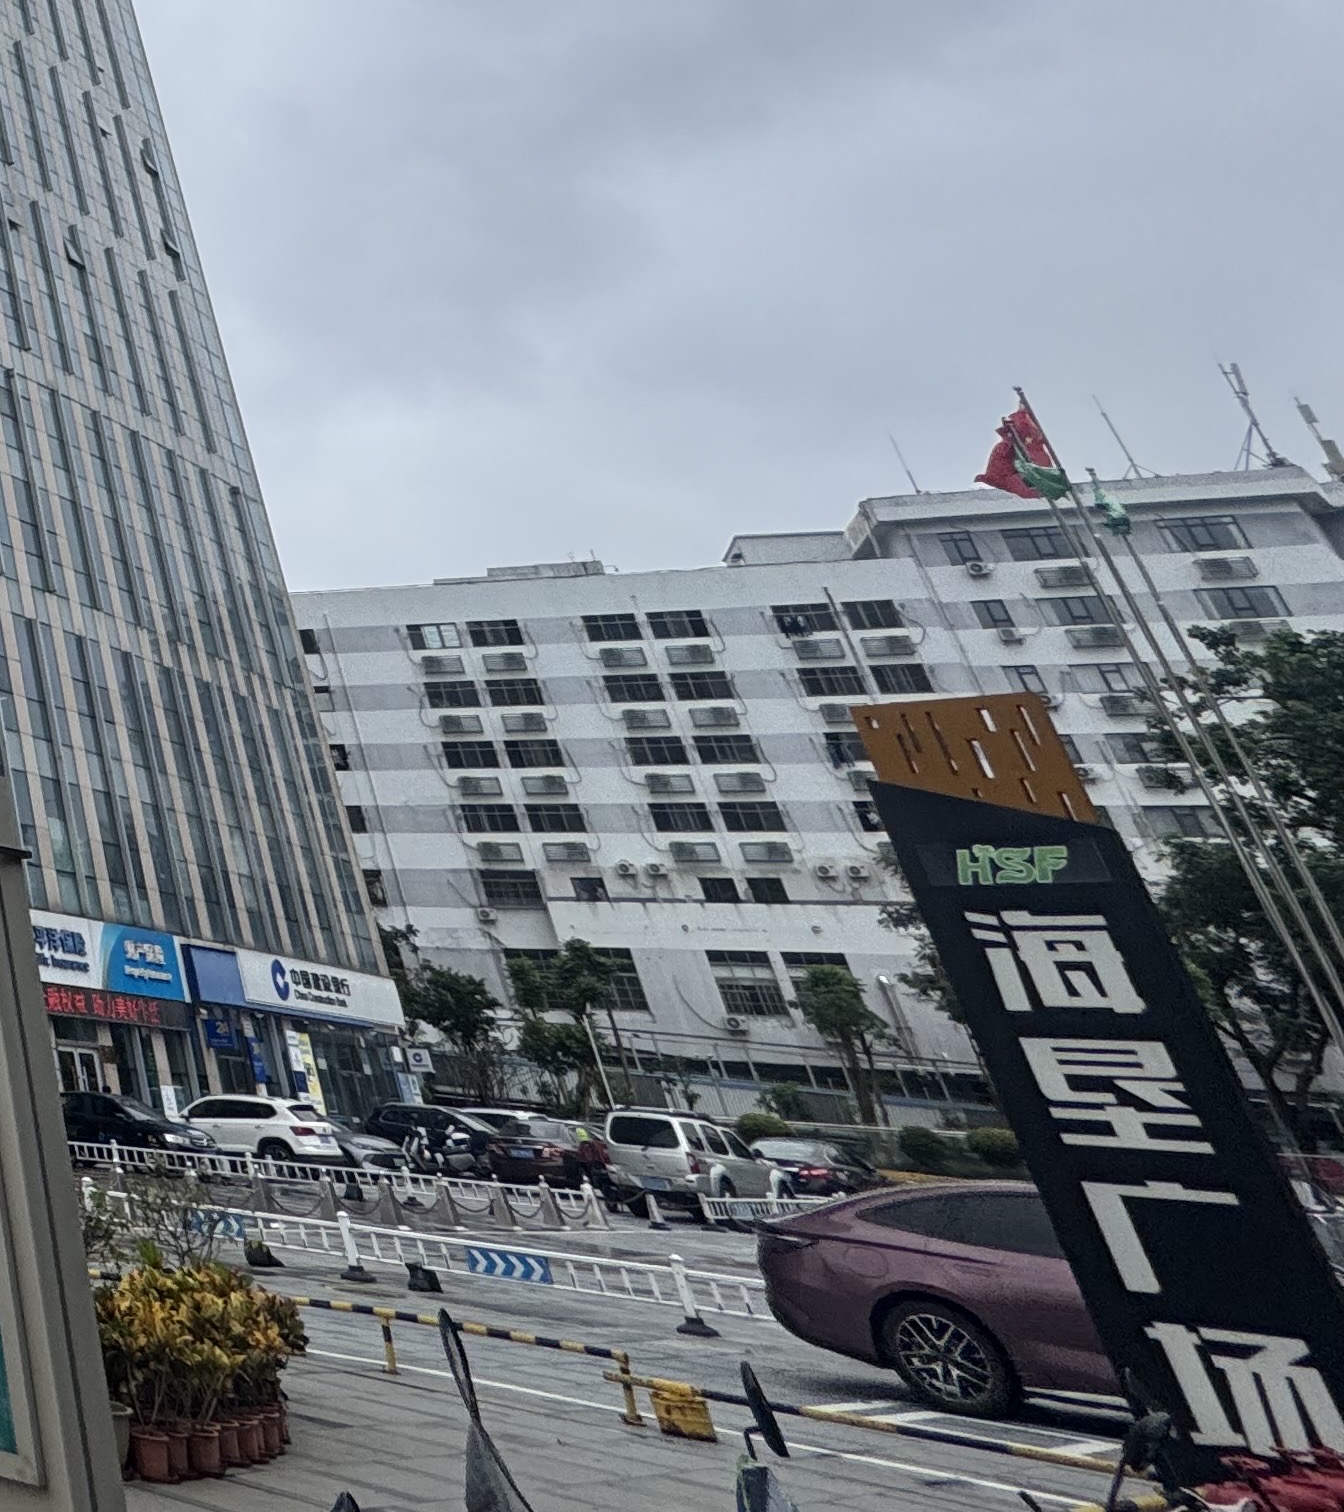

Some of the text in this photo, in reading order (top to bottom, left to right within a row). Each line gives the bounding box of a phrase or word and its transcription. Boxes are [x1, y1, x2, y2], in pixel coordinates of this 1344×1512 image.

[955, 843, 1068, 886] HSF
[289, 968, 351, 996] 中国建设银行
[964, 909, 1344, 1464] 海垦广场
